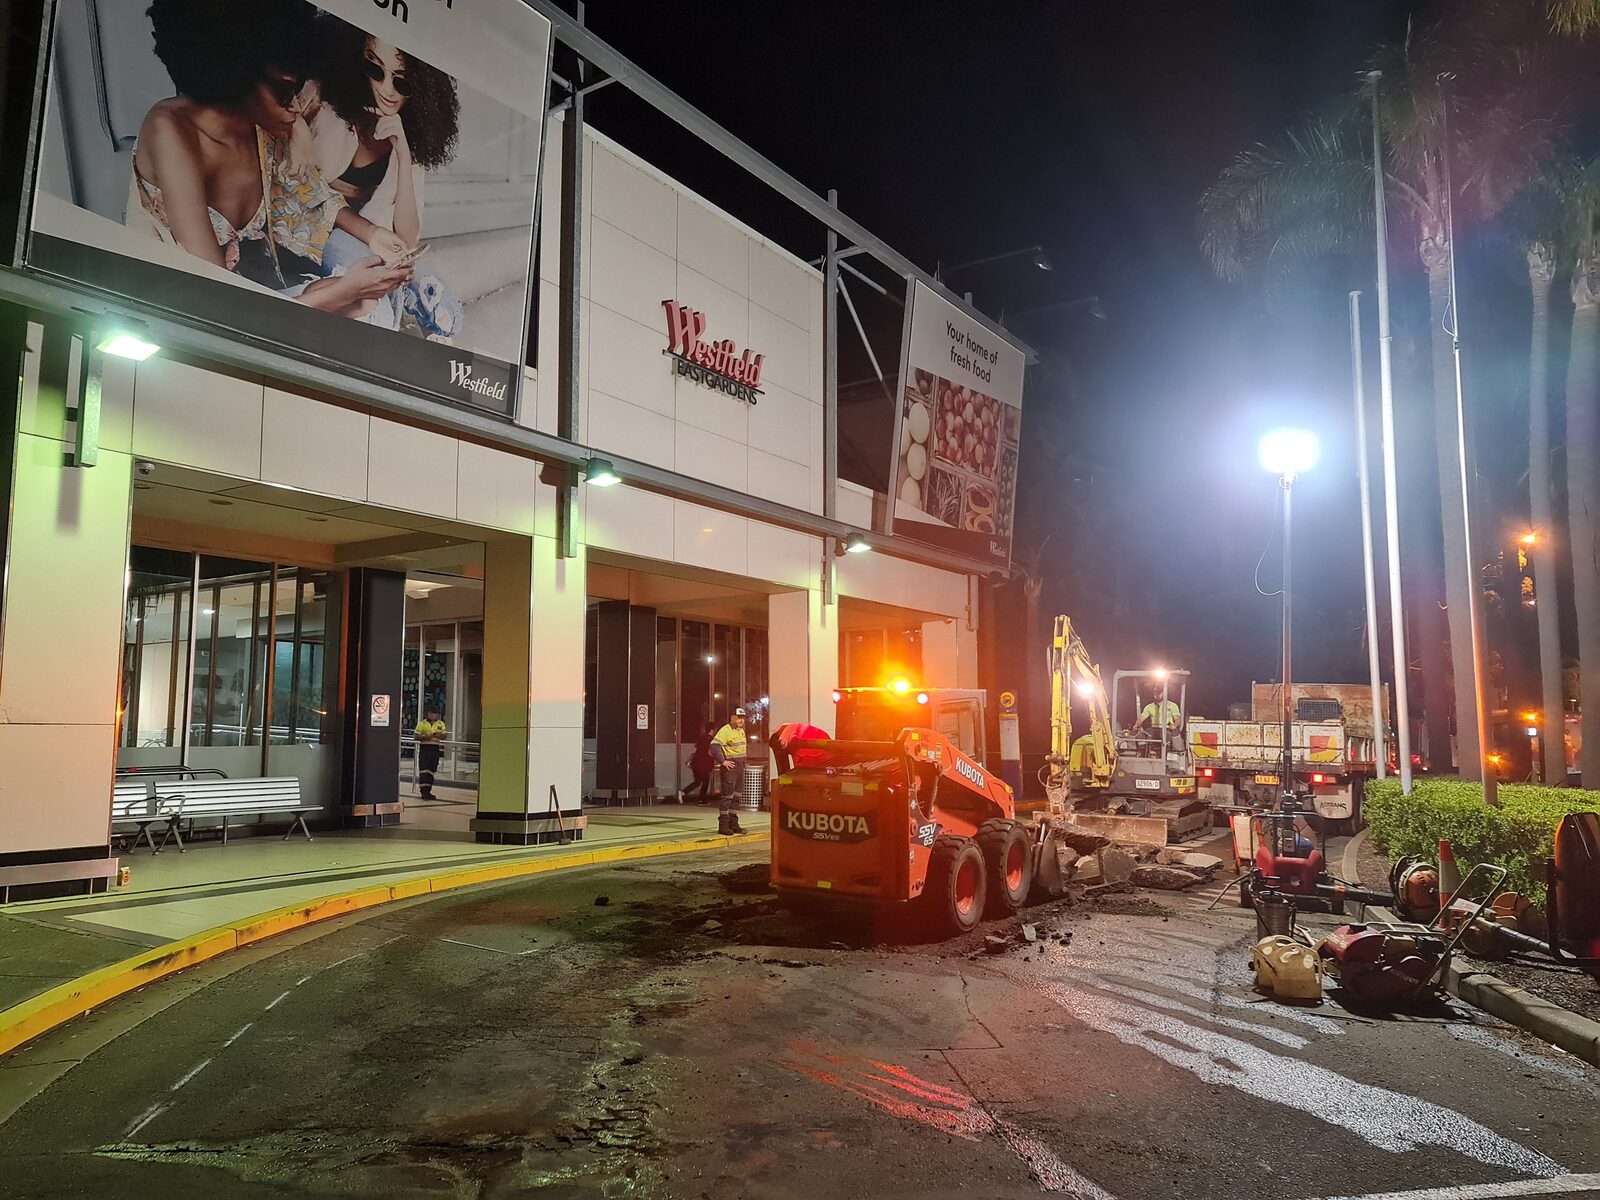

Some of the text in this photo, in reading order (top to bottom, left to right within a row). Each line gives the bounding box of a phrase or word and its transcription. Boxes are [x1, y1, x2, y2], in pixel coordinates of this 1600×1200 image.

[661, 299, 766, 388] Westfield
[946, 320, 999, 366] Your home of
[449, 361, 507, 400] Westfield
[677, 359, 758, 406] EASTGARDENS
[950, 346, 992, 384] fresh food
[955, 757, 986, 789] KUBOTA
[787, 811, 870, 835] KUBOTA
[918, 822, 937, 838] SSV
[923, 835, 934, 846] 65
